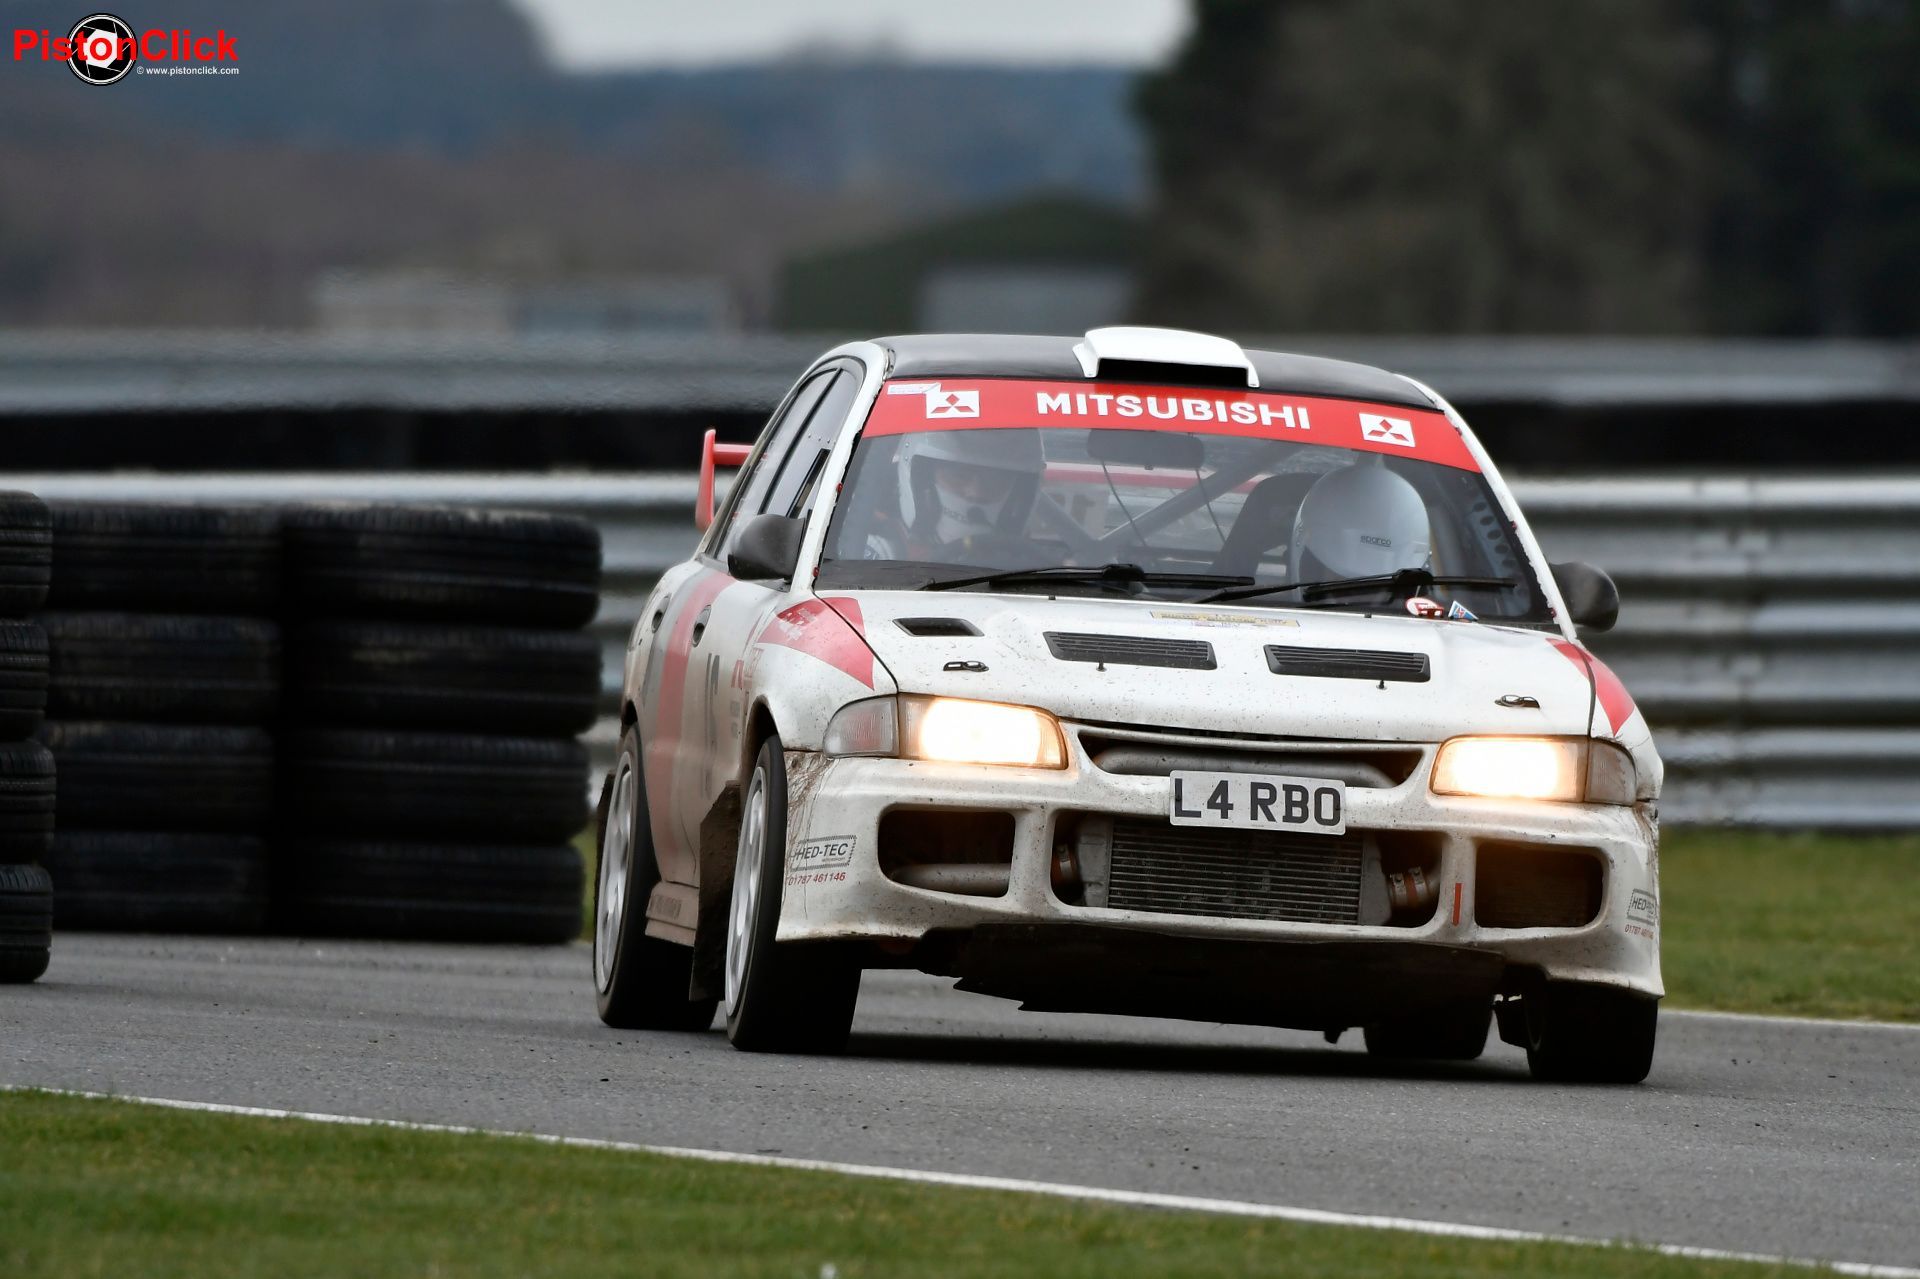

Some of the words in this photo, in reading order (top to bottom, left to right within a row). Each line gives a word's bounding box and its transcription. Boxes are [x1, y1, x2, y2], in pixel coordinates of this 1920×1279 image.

[1036, 392, 1311, 430] MITSUBISHI
[1360, 535, 1392, 547] sparco
[1174, 778, 1234, 820] L4
[1250, 781, 1341, 827] RBO
[796, 843, 849, 860] HED-TEC
[788, 874, 812, 886] 01787
[813, 872, 847, 883] 461146
